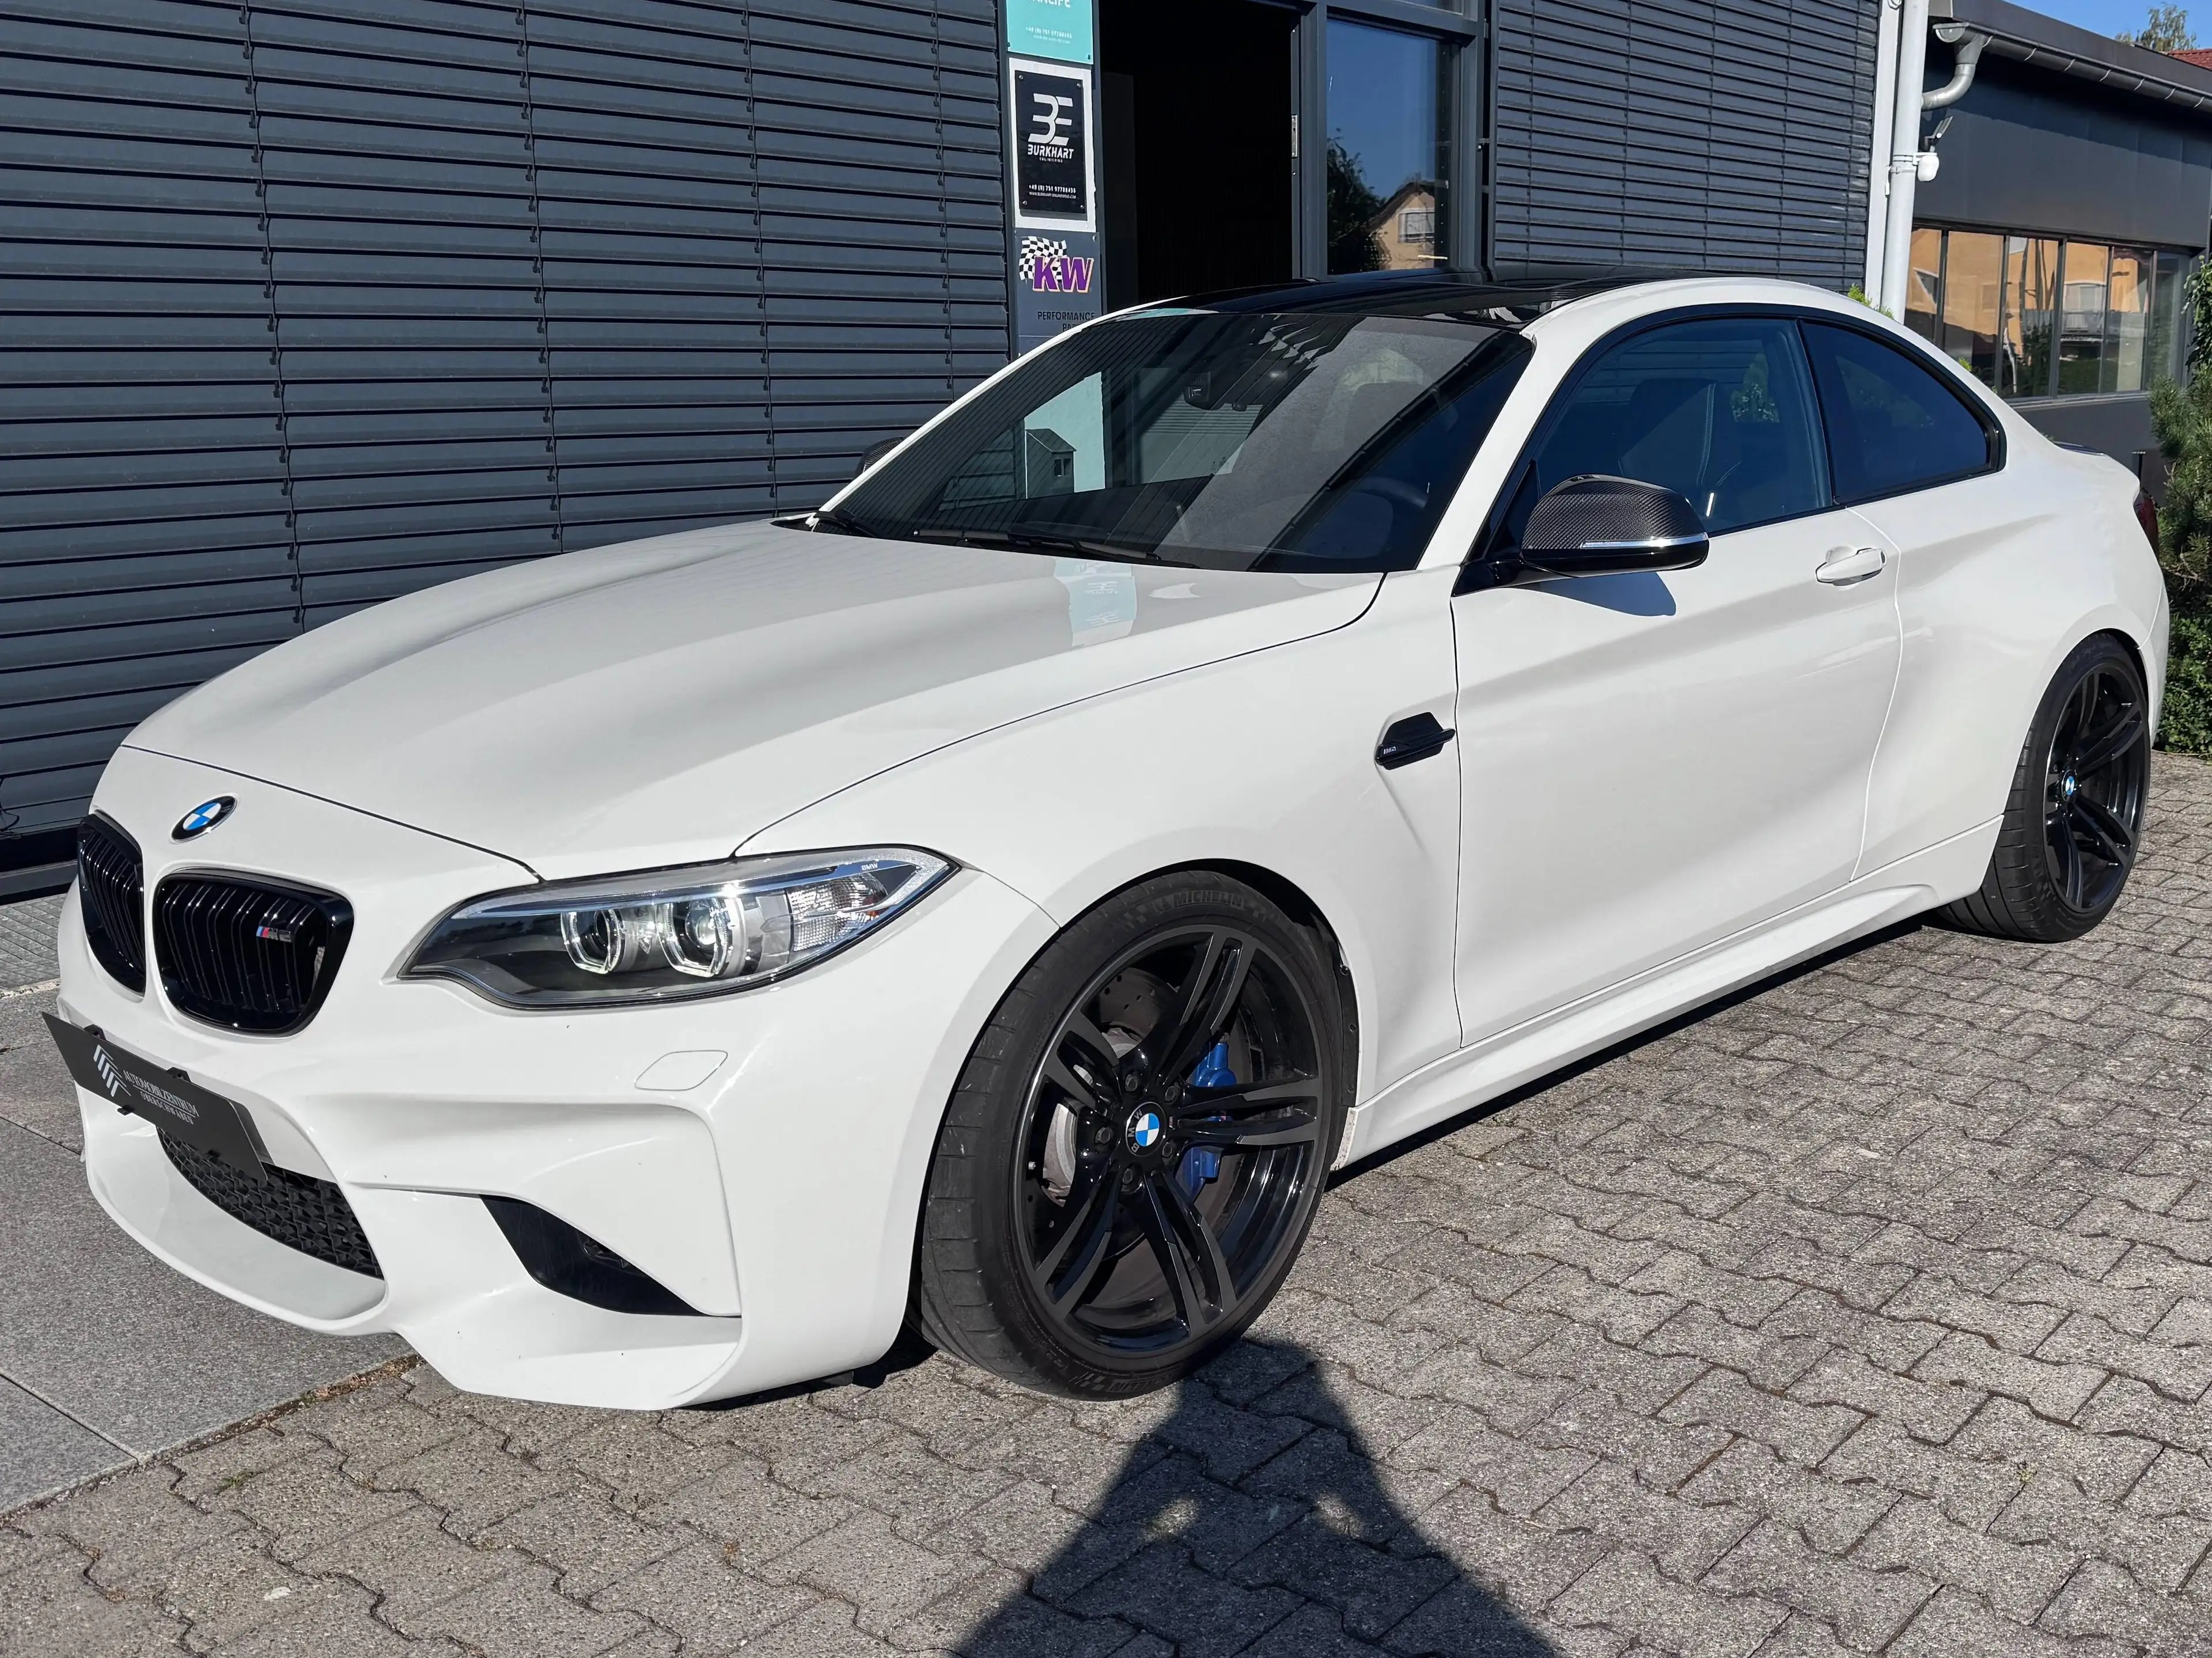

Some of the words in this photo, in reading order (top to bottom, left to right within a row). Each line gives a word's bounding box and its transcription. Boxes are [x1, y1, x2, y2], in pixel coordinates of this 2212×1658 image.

[1027, 144, 1074, 160] BURKHART
[1032, 256, 1094, 293] KW
[1037, 312, 1094, 321] PERFORMANCE
[1173, 890, 1244, 910] MICHELIN
[1128, 1109, 1143, 1152] BMW
